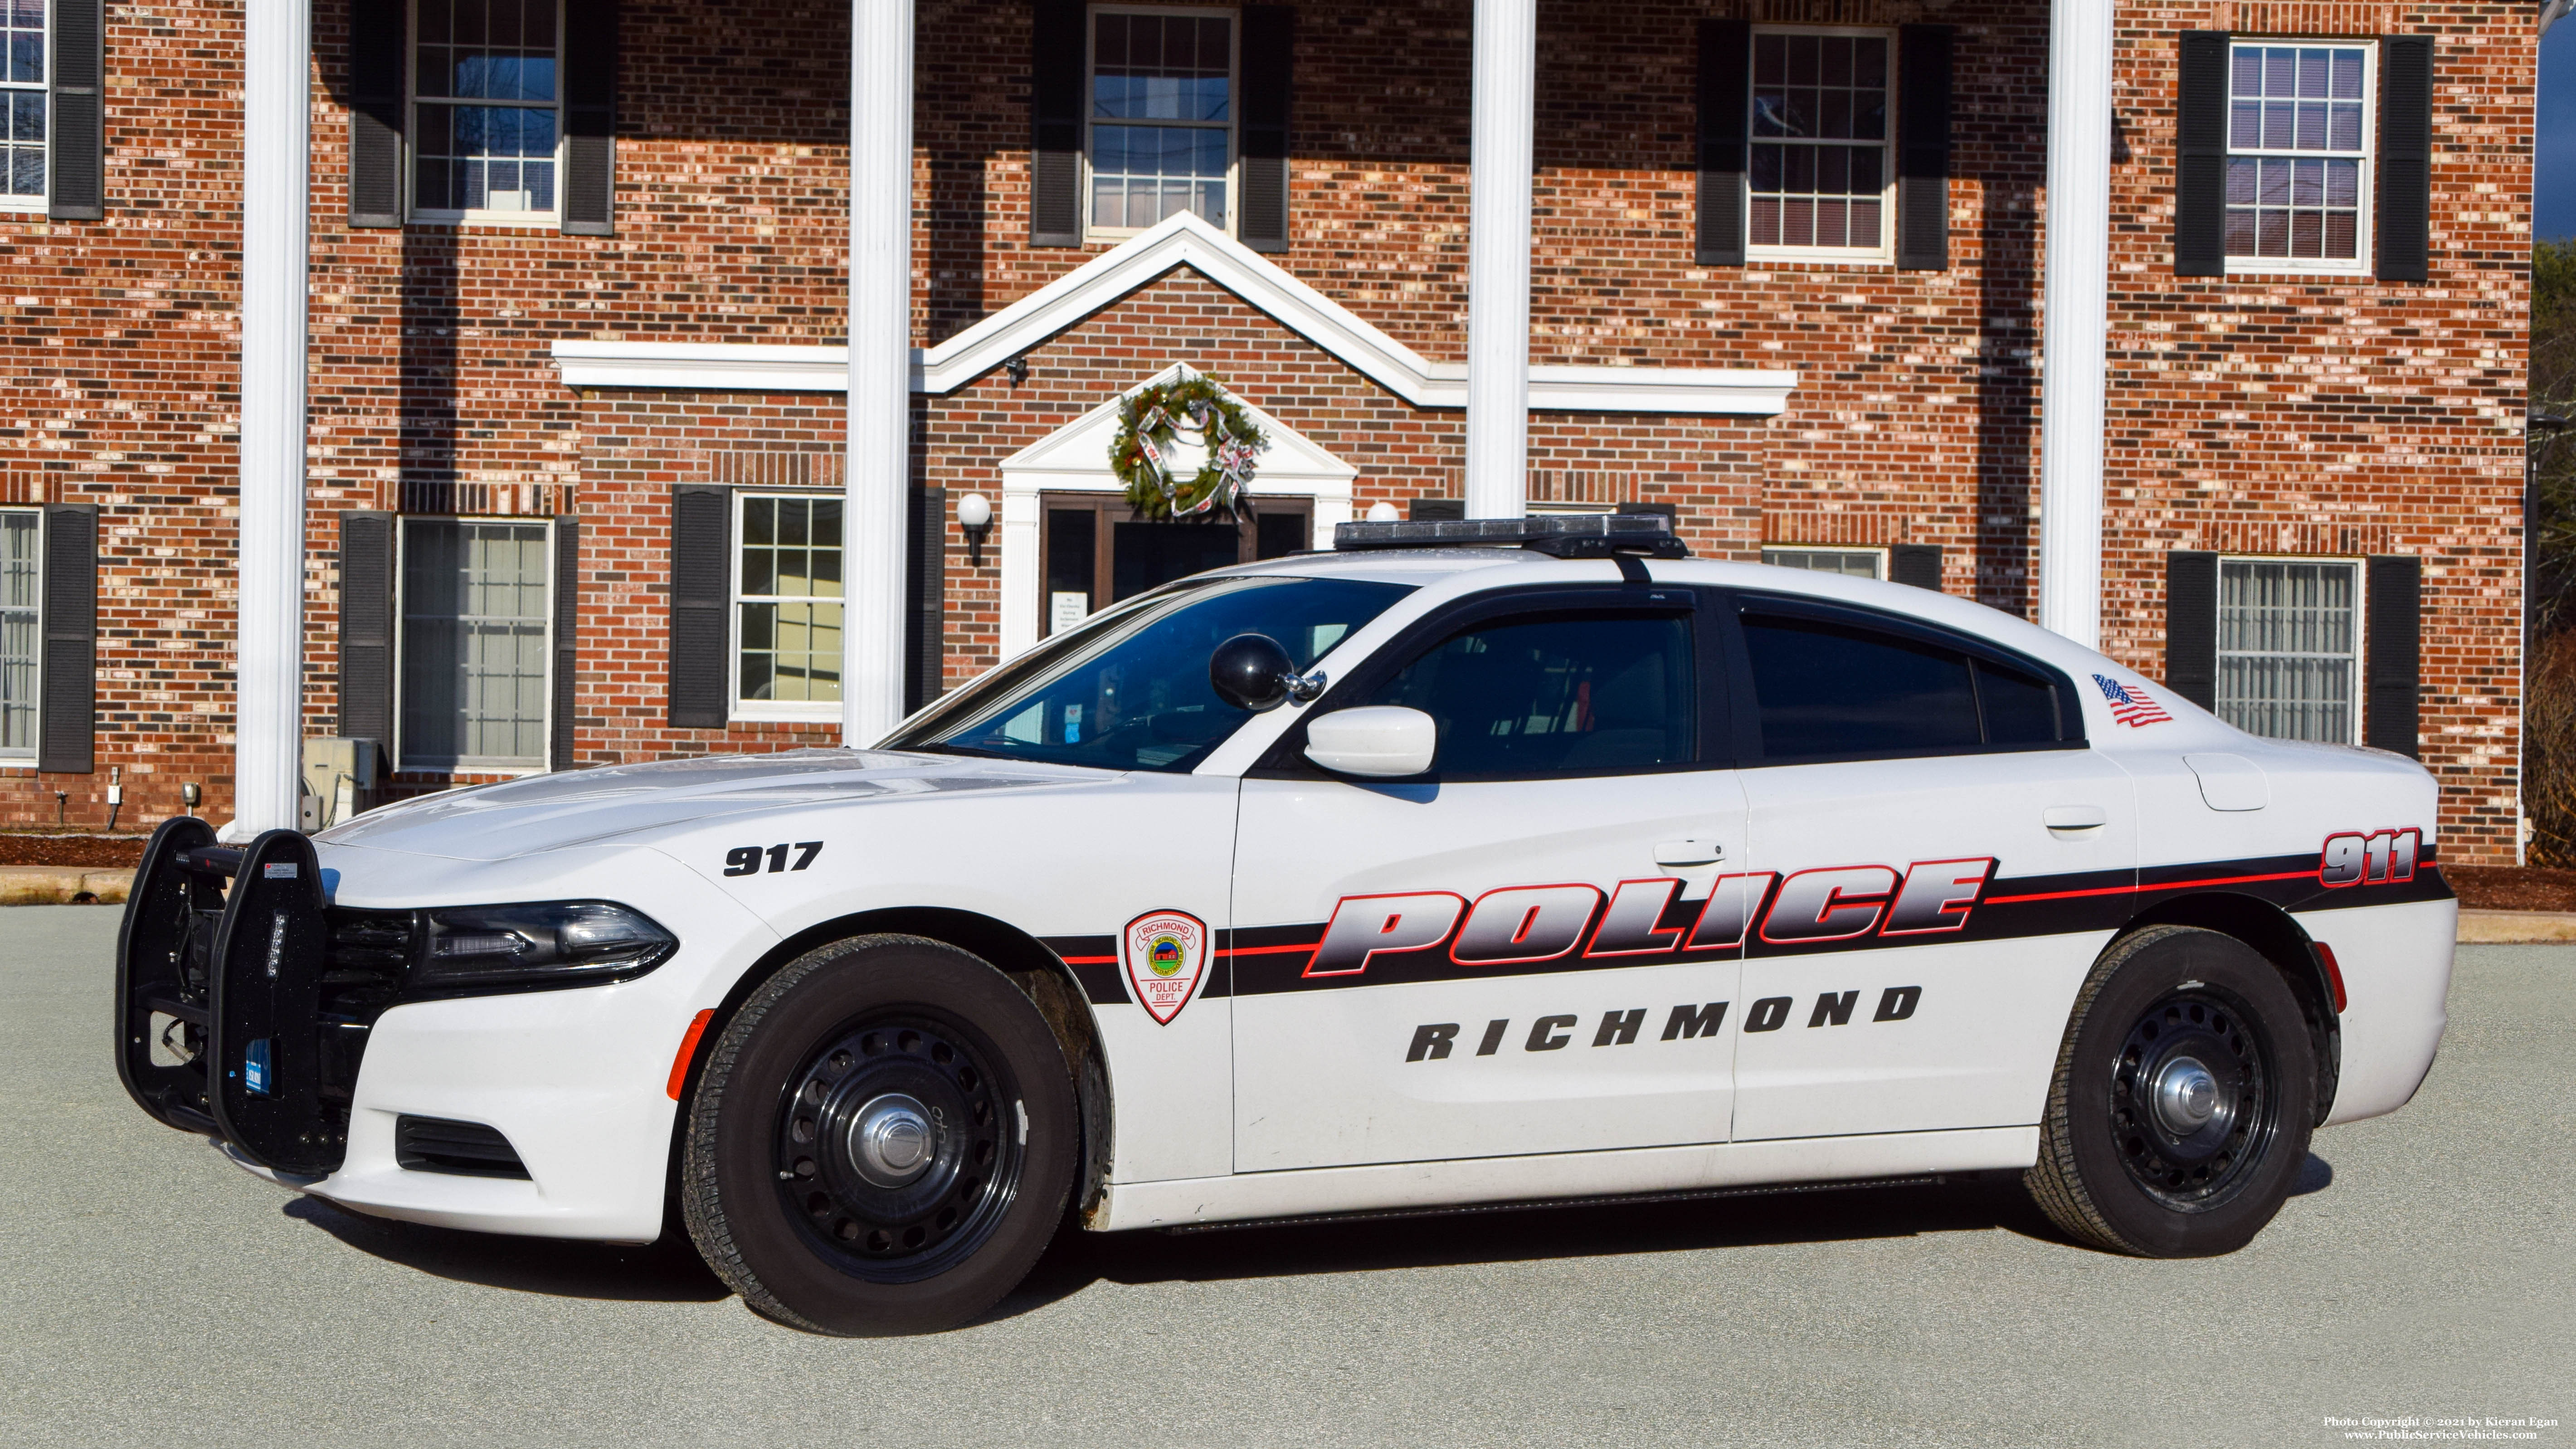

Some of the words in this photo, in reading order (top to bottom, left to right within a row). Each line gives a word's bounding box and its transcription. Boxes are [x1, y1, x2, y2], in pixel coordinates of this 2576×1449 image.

[723, 841, 824, 877] 917
[2319, 827, 2421, 888] 911
[1142, 922, 1189, 935] RICHMOND
[1300, 856, 1995, 978] POLICE
[1155, 936, 1177, 944] RICHMOND
[1150, 982, 1183, 993] POLICE
[1405, 985, 1923, 1063] RICHMOND
